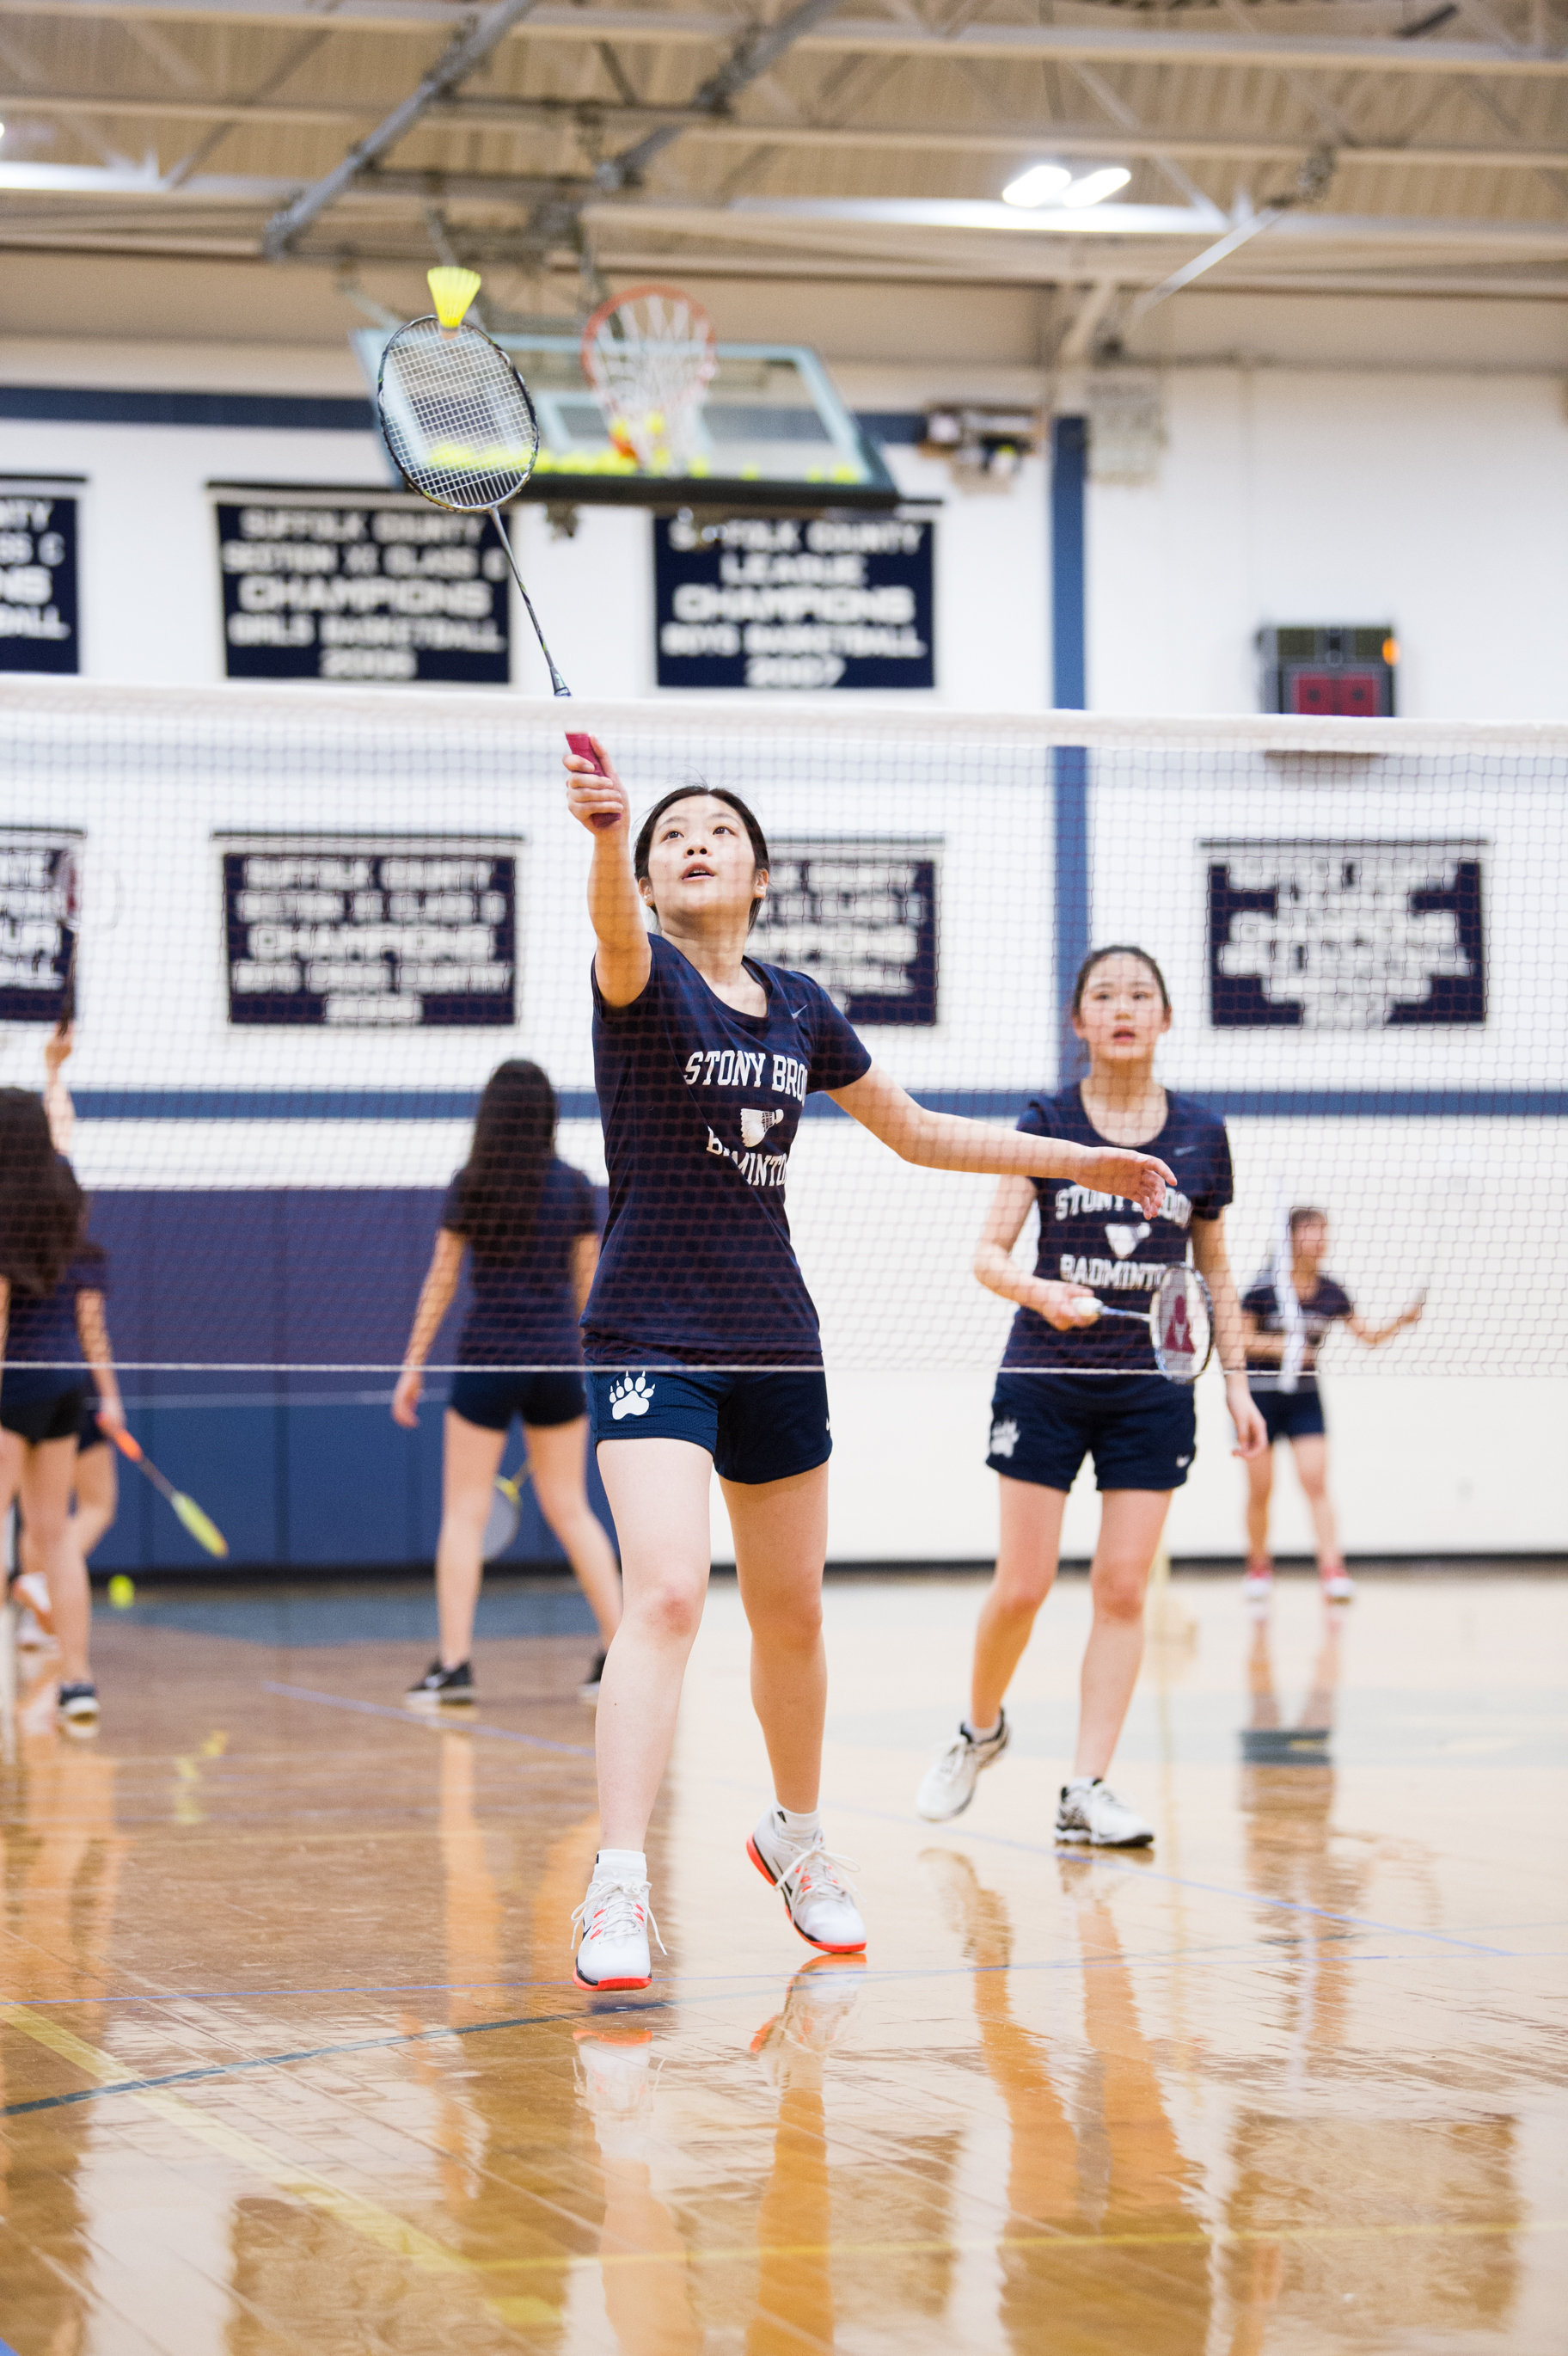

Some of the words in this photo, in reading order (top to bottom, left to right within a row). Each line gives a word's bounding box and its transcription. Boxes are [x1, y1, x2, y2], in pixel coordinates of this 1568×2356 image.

[237, 575, 494, 617] CHAMPIONS
[672, 584, 916, 625] CHAMPIONS
[683, 1050, 766, 1087] STONY
[771, 1054, 808, 1107] BRO
